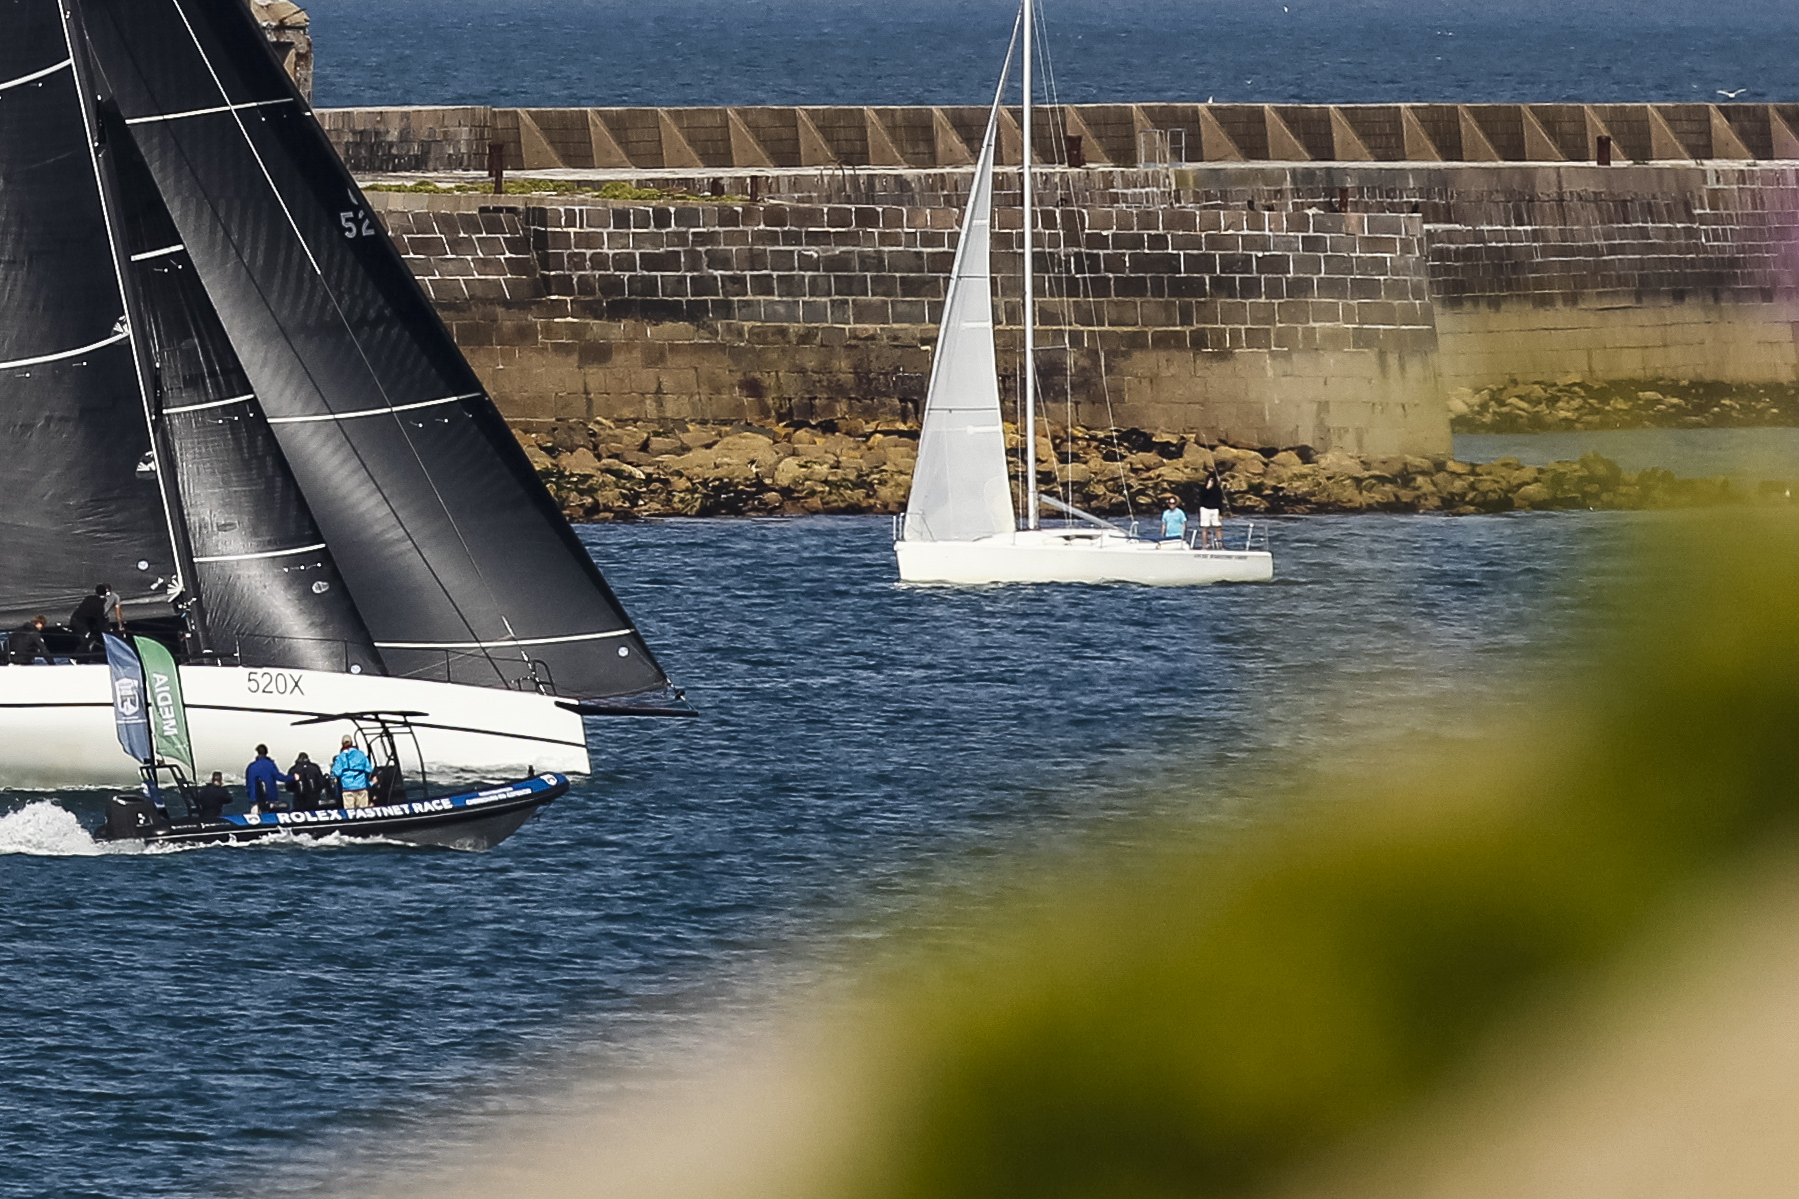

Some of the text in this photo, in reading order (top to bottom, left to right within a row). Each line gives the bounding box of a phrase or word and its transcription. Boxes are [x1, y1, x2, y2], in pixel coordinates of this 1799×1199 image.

[247, 671, 305, 696] 520X
[276, 798, 453, 824] ROLEX FASTNET RACE
